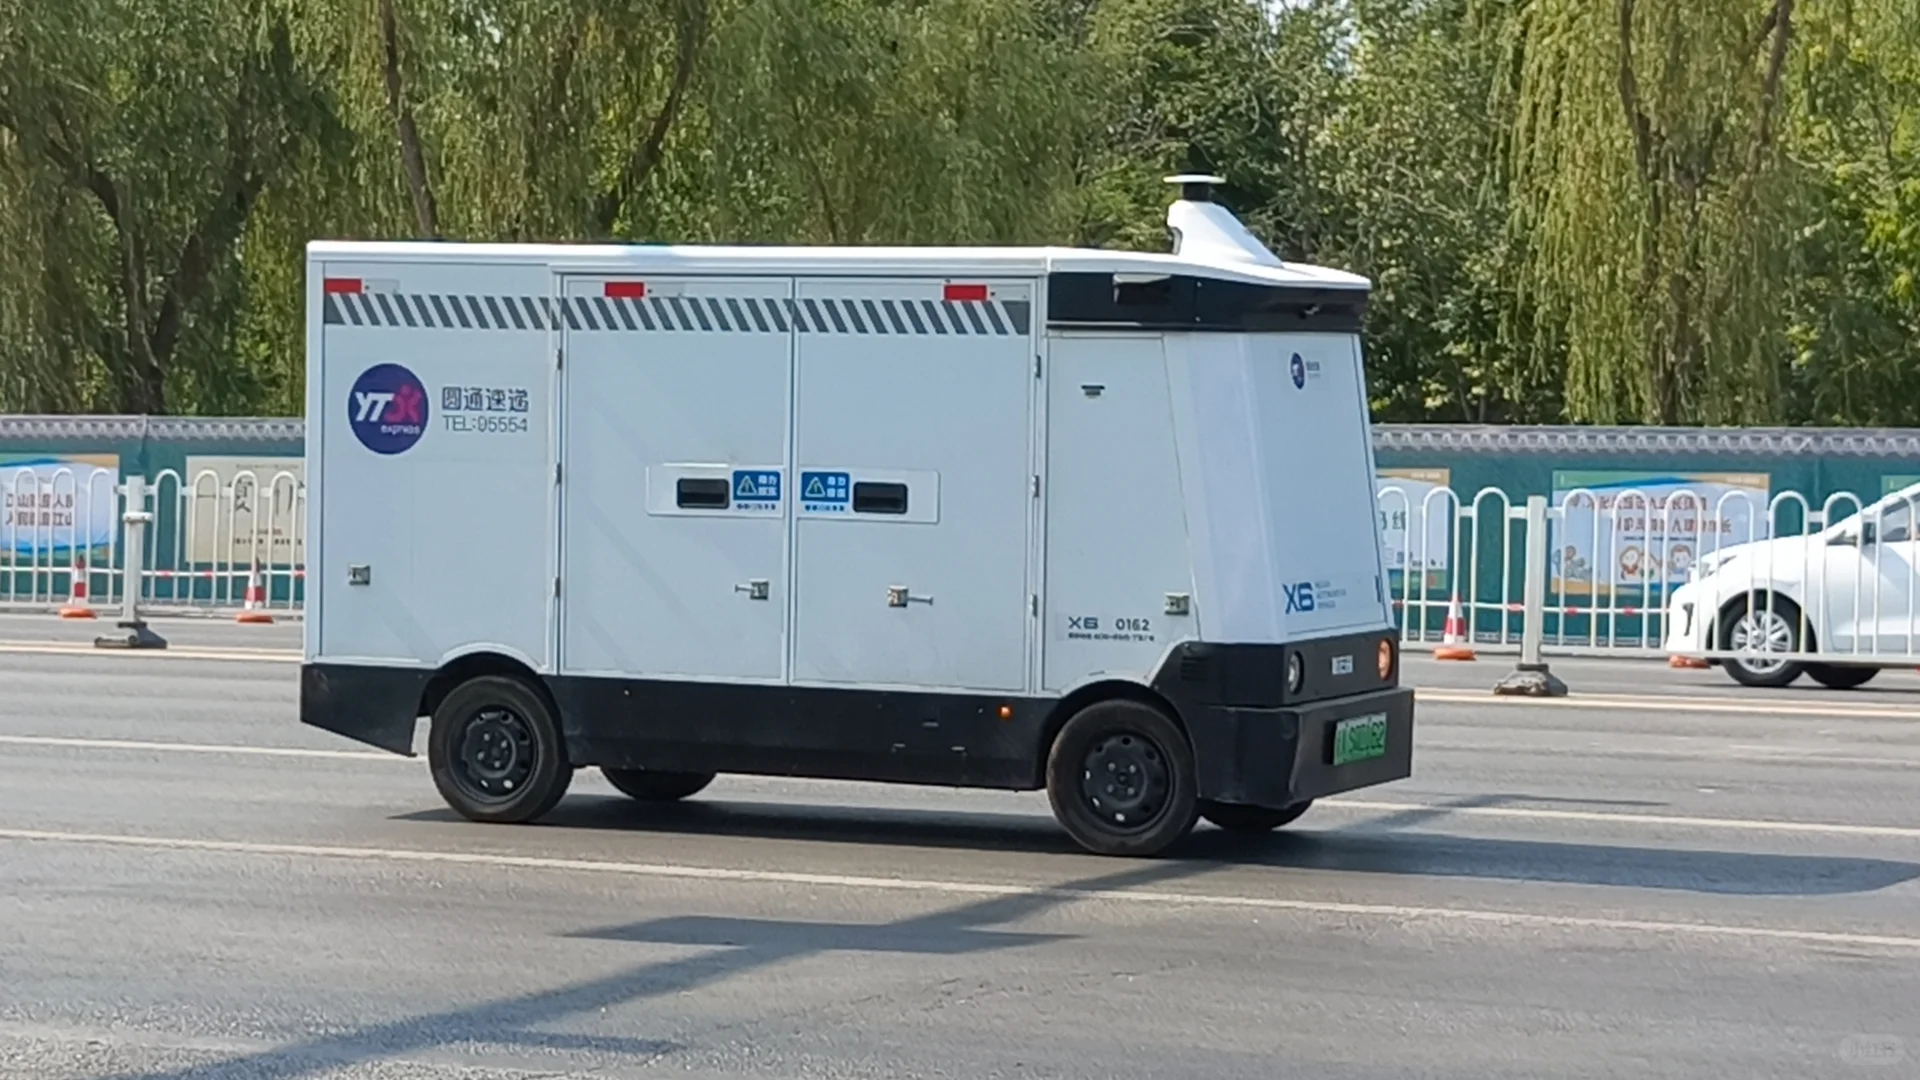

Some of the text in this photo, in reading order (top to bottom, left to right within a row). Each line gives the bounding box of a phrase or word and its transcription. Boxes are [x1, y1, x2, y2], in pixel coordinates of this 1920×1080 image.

[441, 386, 529, 413] 圆通速递
[1281, 581, 1315, 615] X6
[1068, 616, 1150, 631] X6 0162
